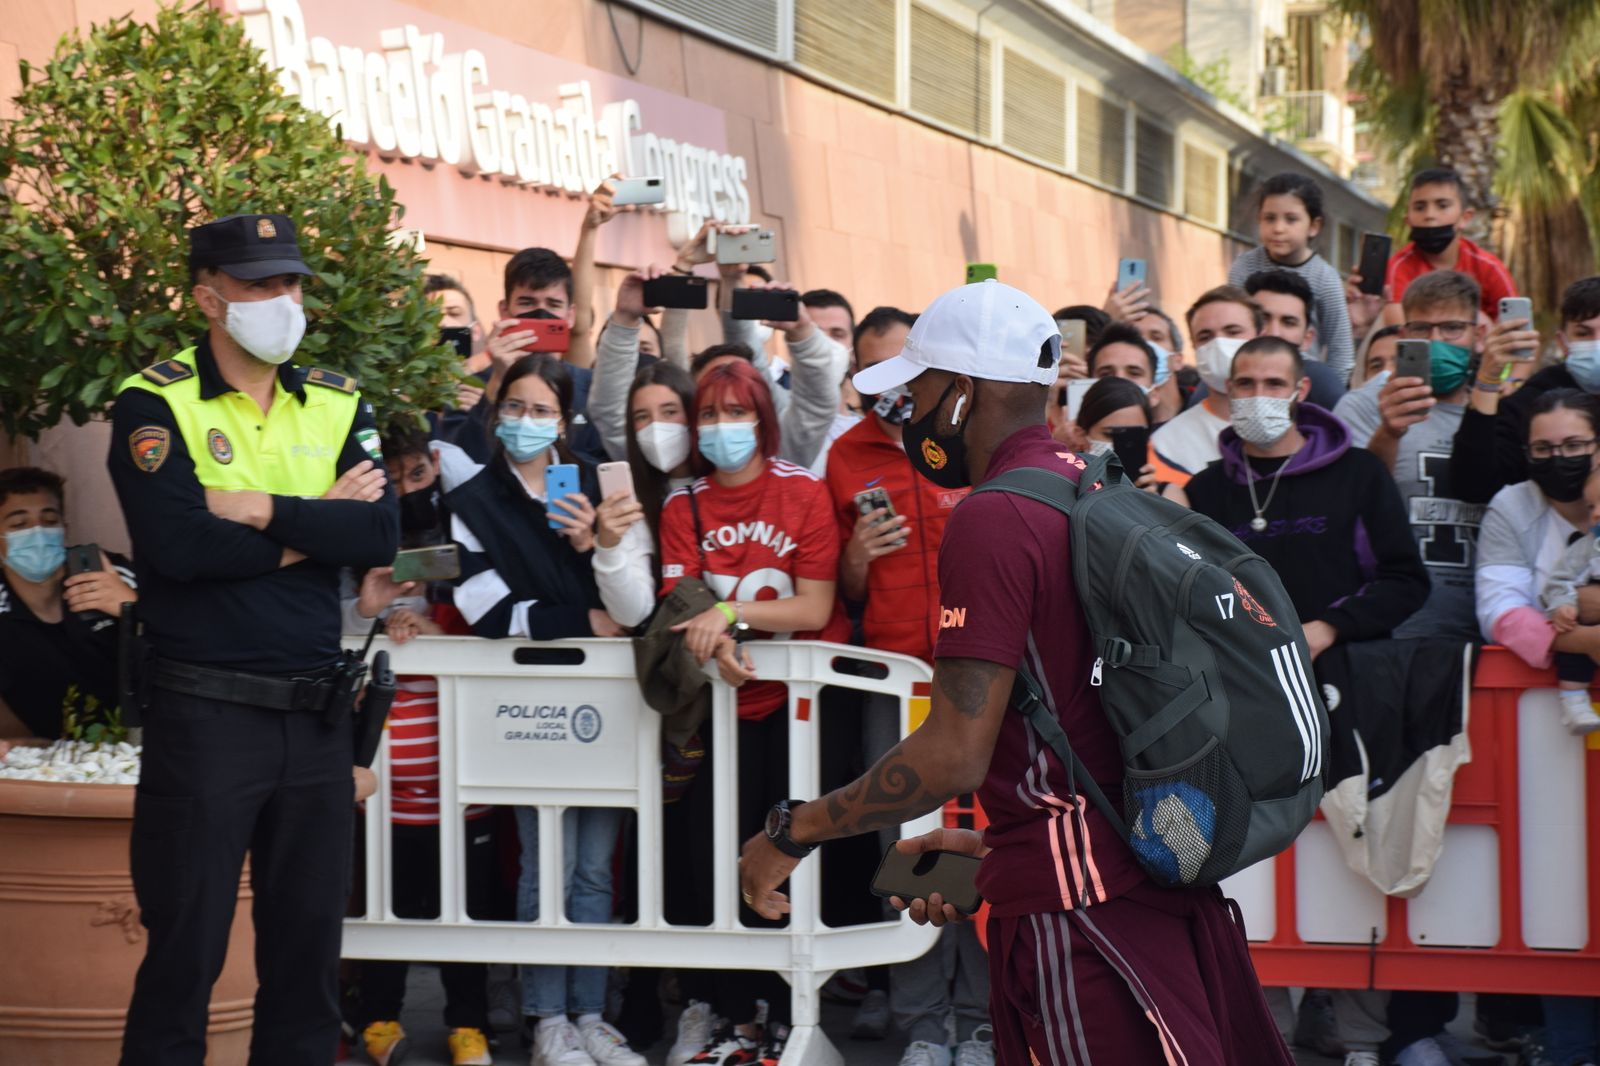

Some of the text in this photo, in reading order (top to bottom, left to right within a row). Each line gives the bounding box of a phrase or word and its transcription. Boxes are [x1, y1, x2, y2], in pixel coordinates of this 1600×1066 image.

[462, 48, 619, 195] Granada
[622, 98, 751, 241] Congress
[1215, 592, 1235, 620] 17
[496, 705, 568, 719] POLICIA
[536, 722, 567, 730] LOCAL
[504, 731, 568, 742] GRANADA
